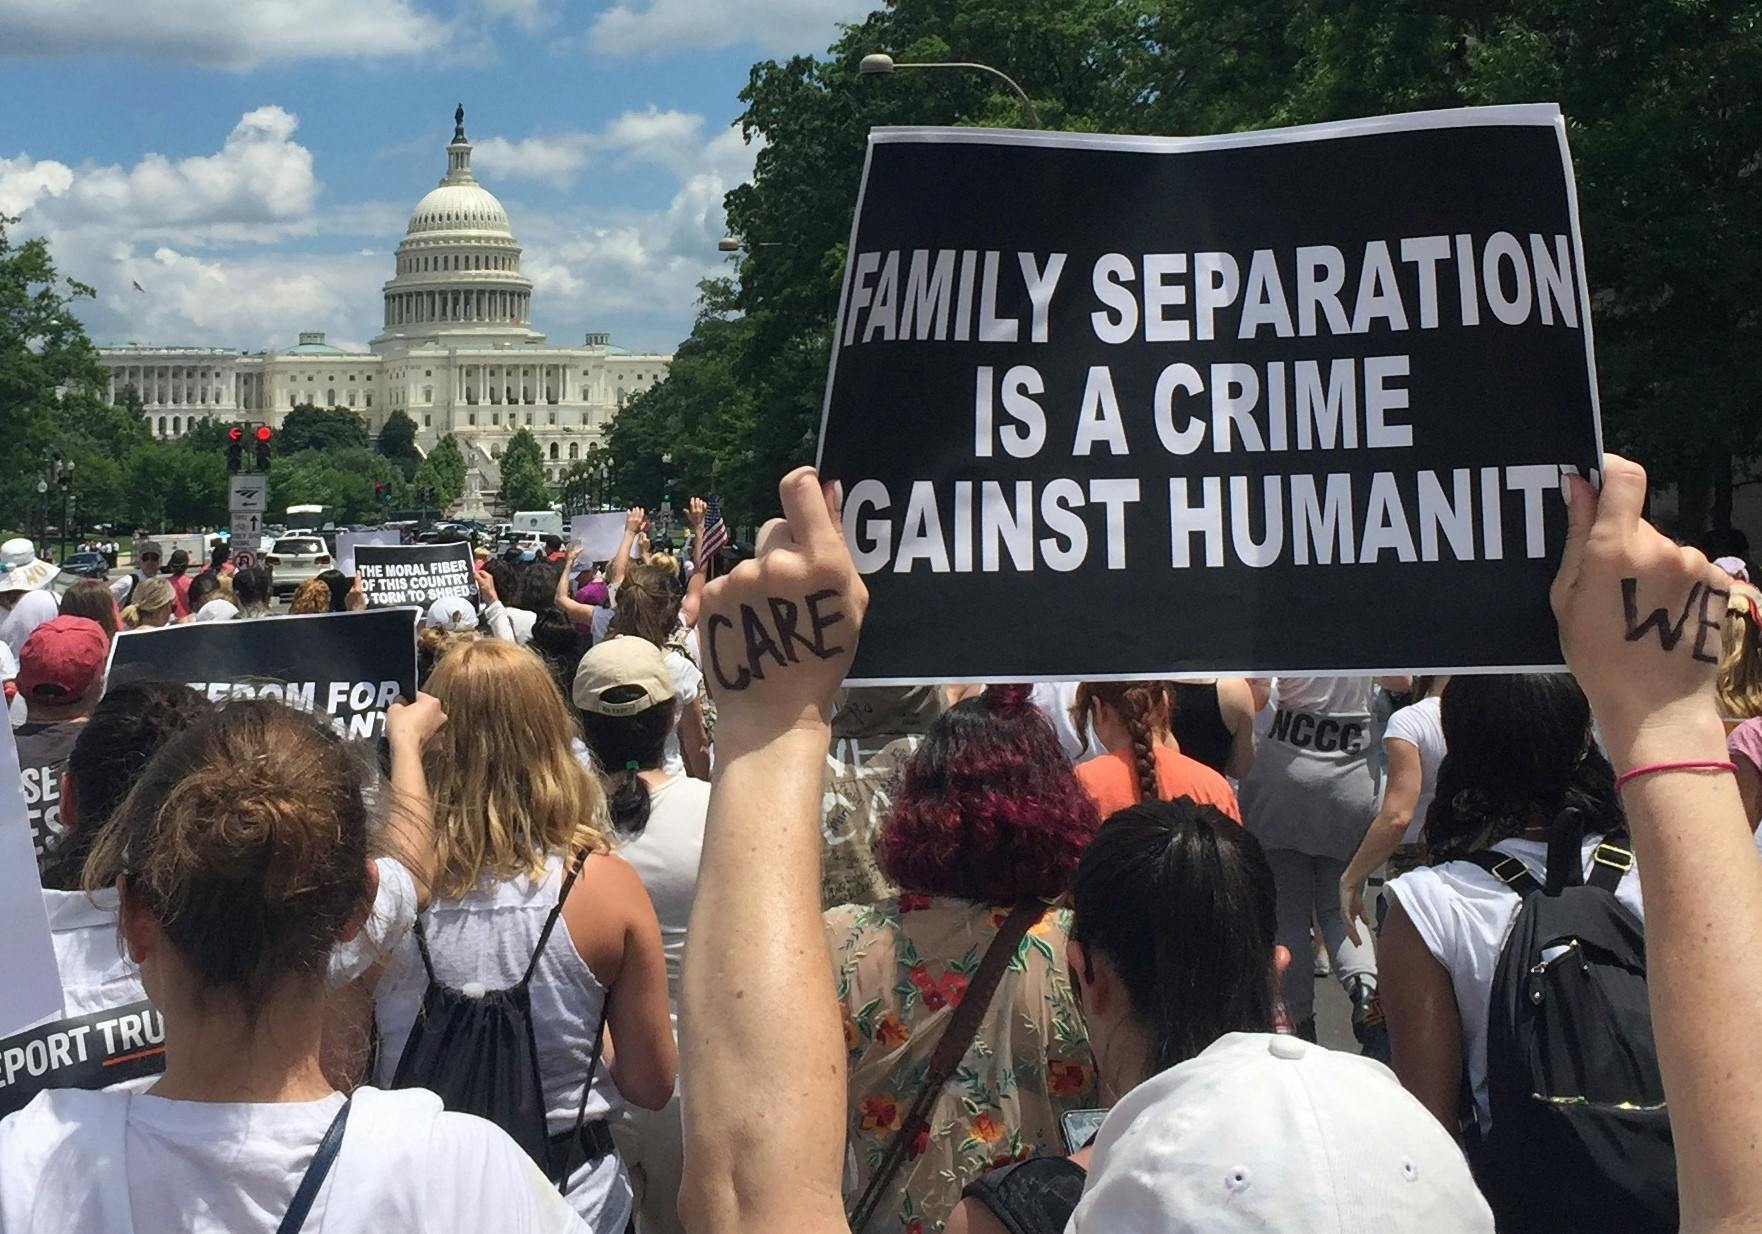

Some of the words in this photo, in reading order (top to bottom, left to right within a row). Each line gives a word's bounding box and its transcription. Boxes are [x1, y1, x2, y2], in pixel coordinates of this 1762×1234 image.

[844, 249, 1068, 347] FAMILY
[1091, 231, 1579, 344] SEPARATION
[975, 364, 1047, 459] IS
[1072, 365, 1130, 456] A
[1154, 354, 1414, 456] CRIME
[842, 477, 1141, 575] GAINST
[359, 564, 384, 578] THE
[385, 562, 428, 577] MORAL
[430, 559, 468, 574] FIBER
[360, 579, 376, 592] OF
[378, 577, 408, 591] THIS
[410, 571, 470, 588] COUNTRY
[371, 593, 407, 605] TORN
[407, 589, 426, 602] TO
[708, 588, 846, 690] CARE
[1620, 577, 1731, 665] WE
[327, 681, 402, 714] FOR
[1267, 709, 1362, 755] NCCC
